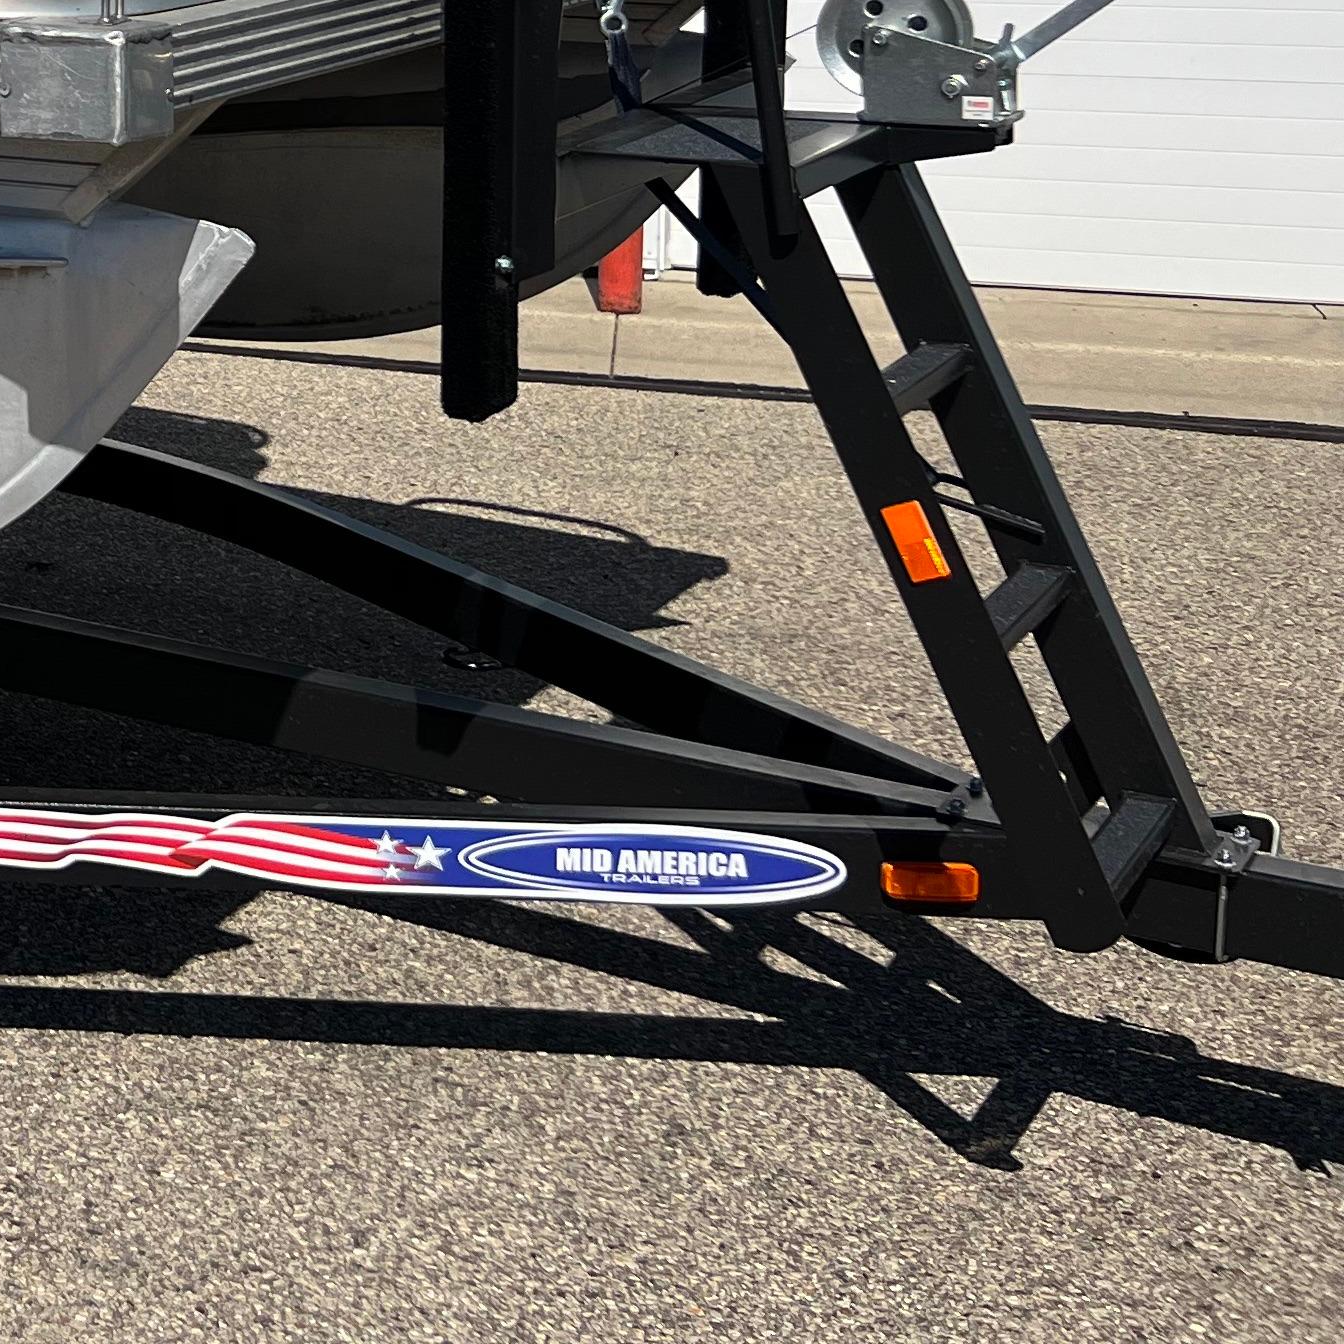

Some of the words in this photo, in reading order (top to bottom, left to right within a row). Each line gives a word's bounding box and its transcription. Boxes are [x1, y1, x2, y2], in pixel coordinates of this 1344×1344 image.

[556, 847, 612, 872] MID
[617, 849, 749, 877] AMERICA
[600, 873, 700, 886] TRAILERS
